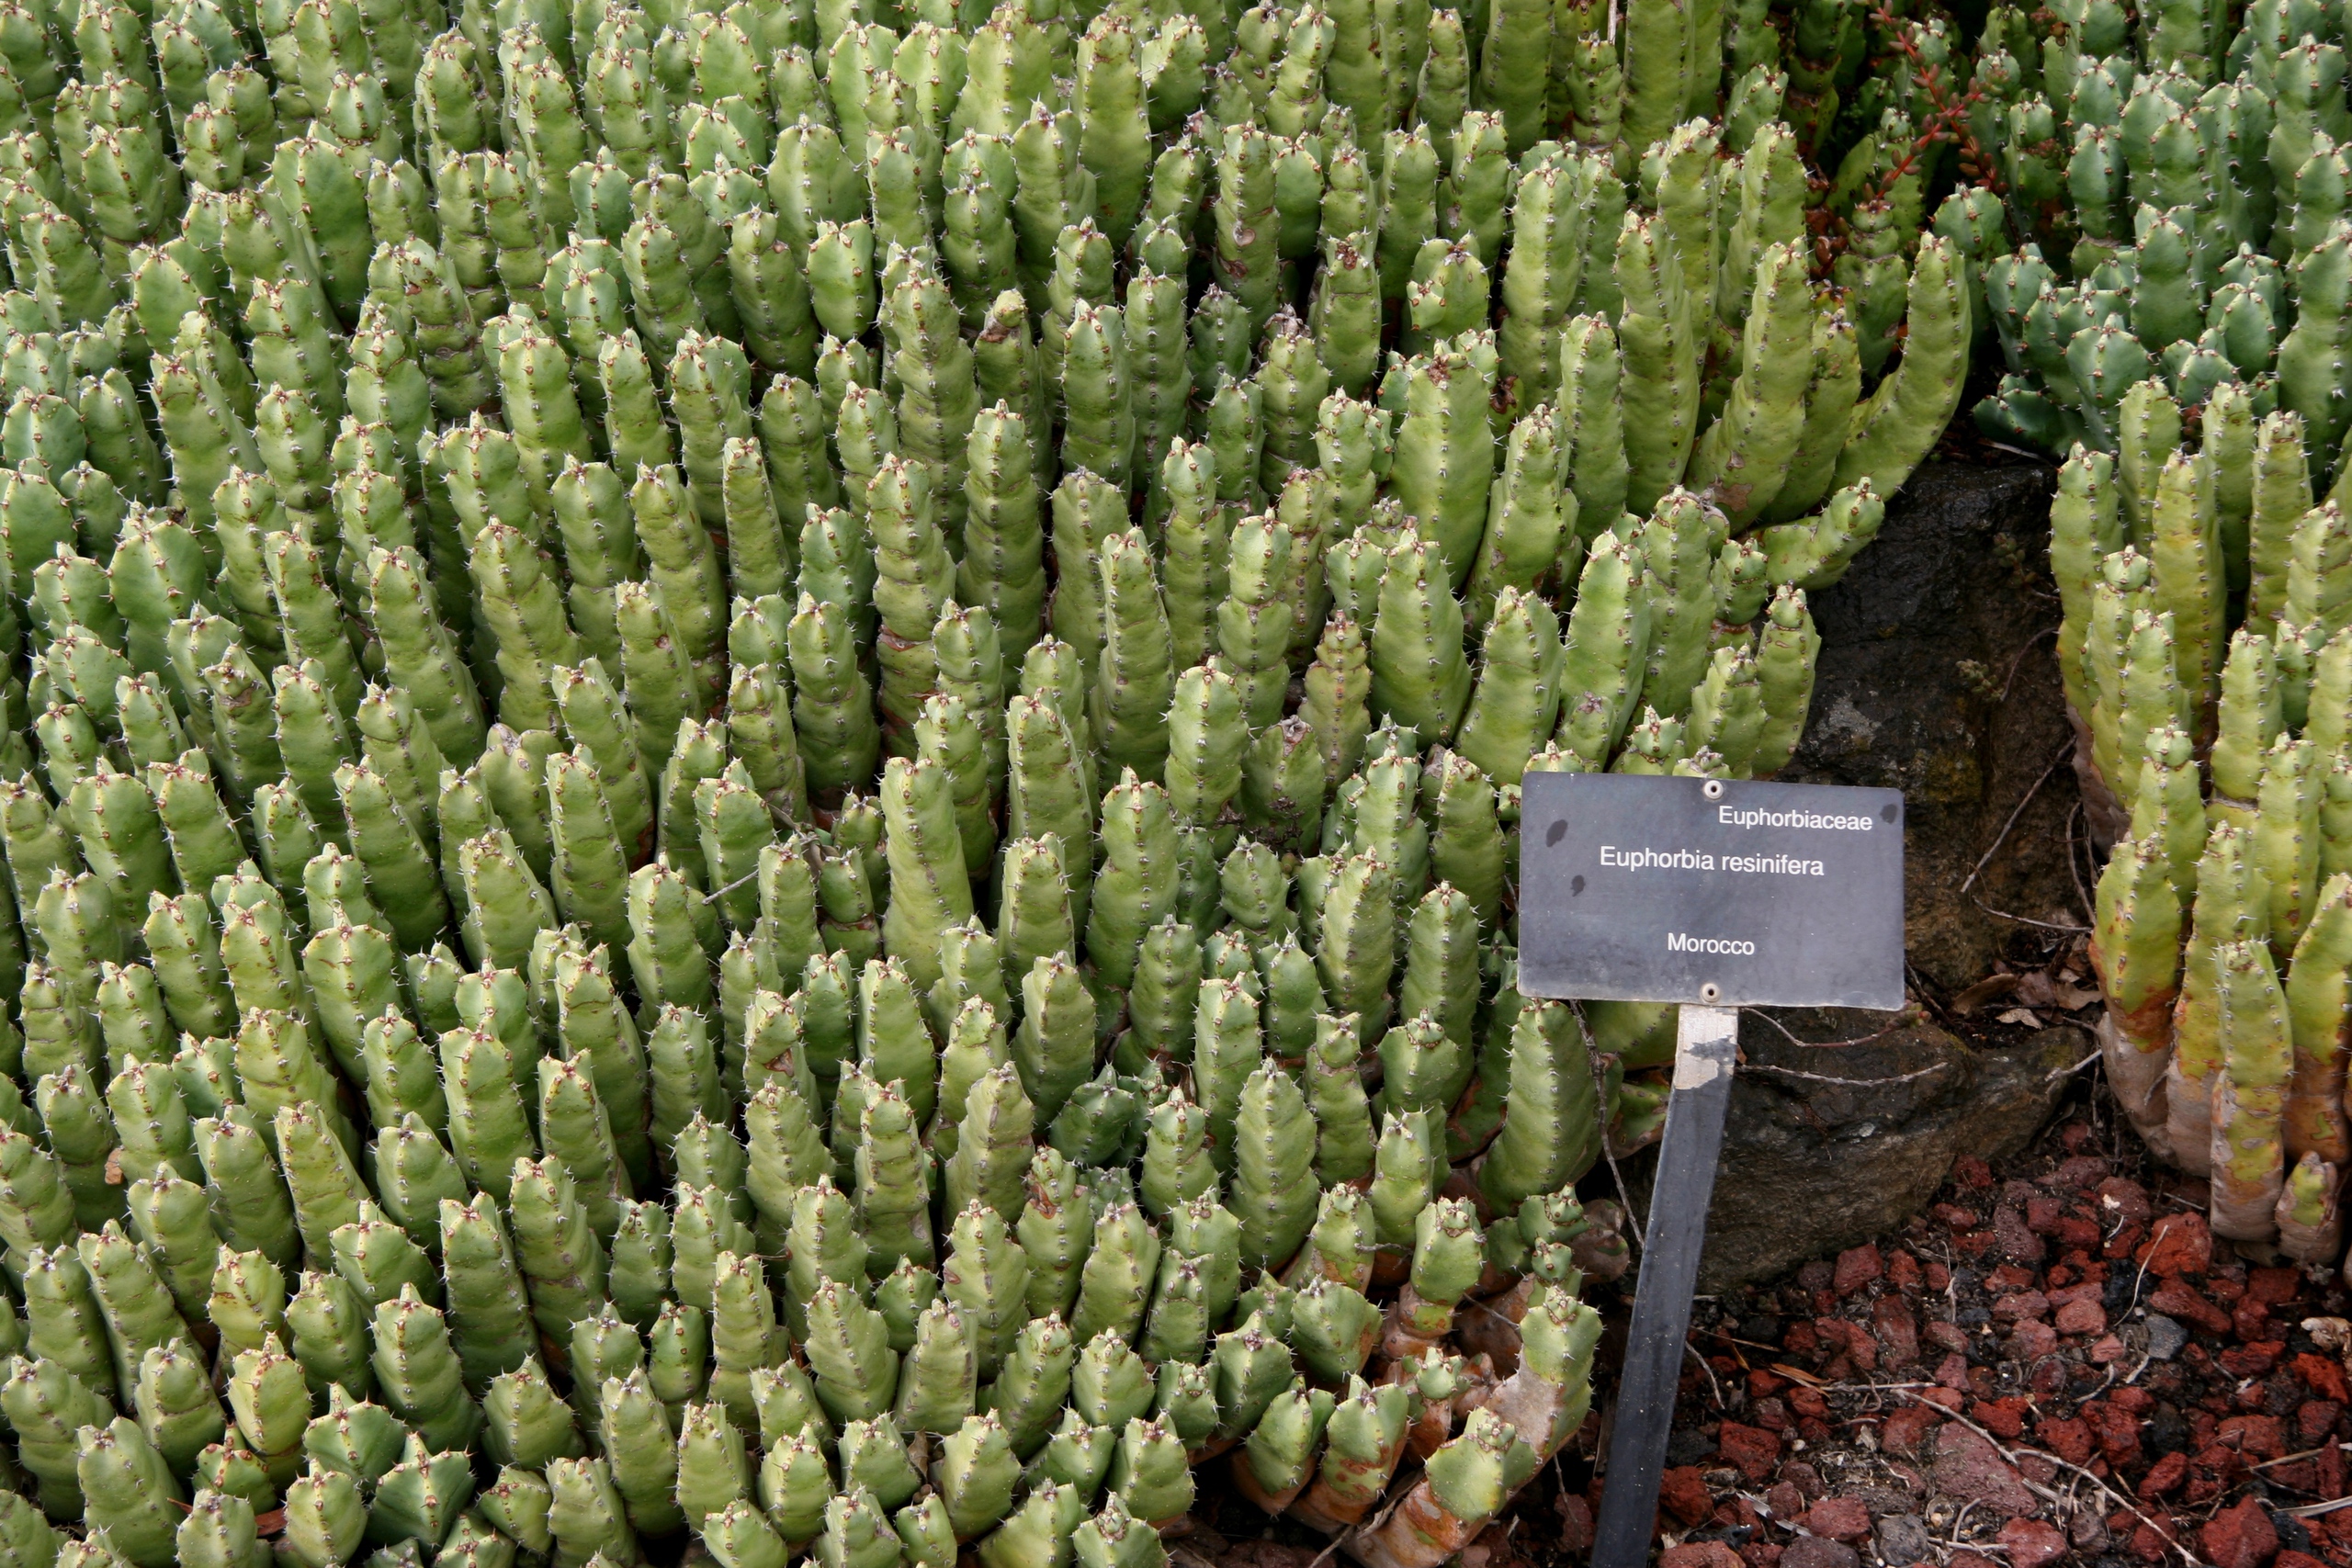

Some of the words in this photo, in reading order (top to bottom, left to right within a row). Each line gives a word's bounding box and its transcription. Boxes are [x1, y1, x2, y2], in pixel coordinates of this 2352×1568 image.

[1719, 805, 1873, 830] Euphorbiaceae
[1600, 846, 1714, 872] Euphorbia
[1722, 853, 1825, 875] resinifera
[1668, 932, 1756, 955] Morocco
